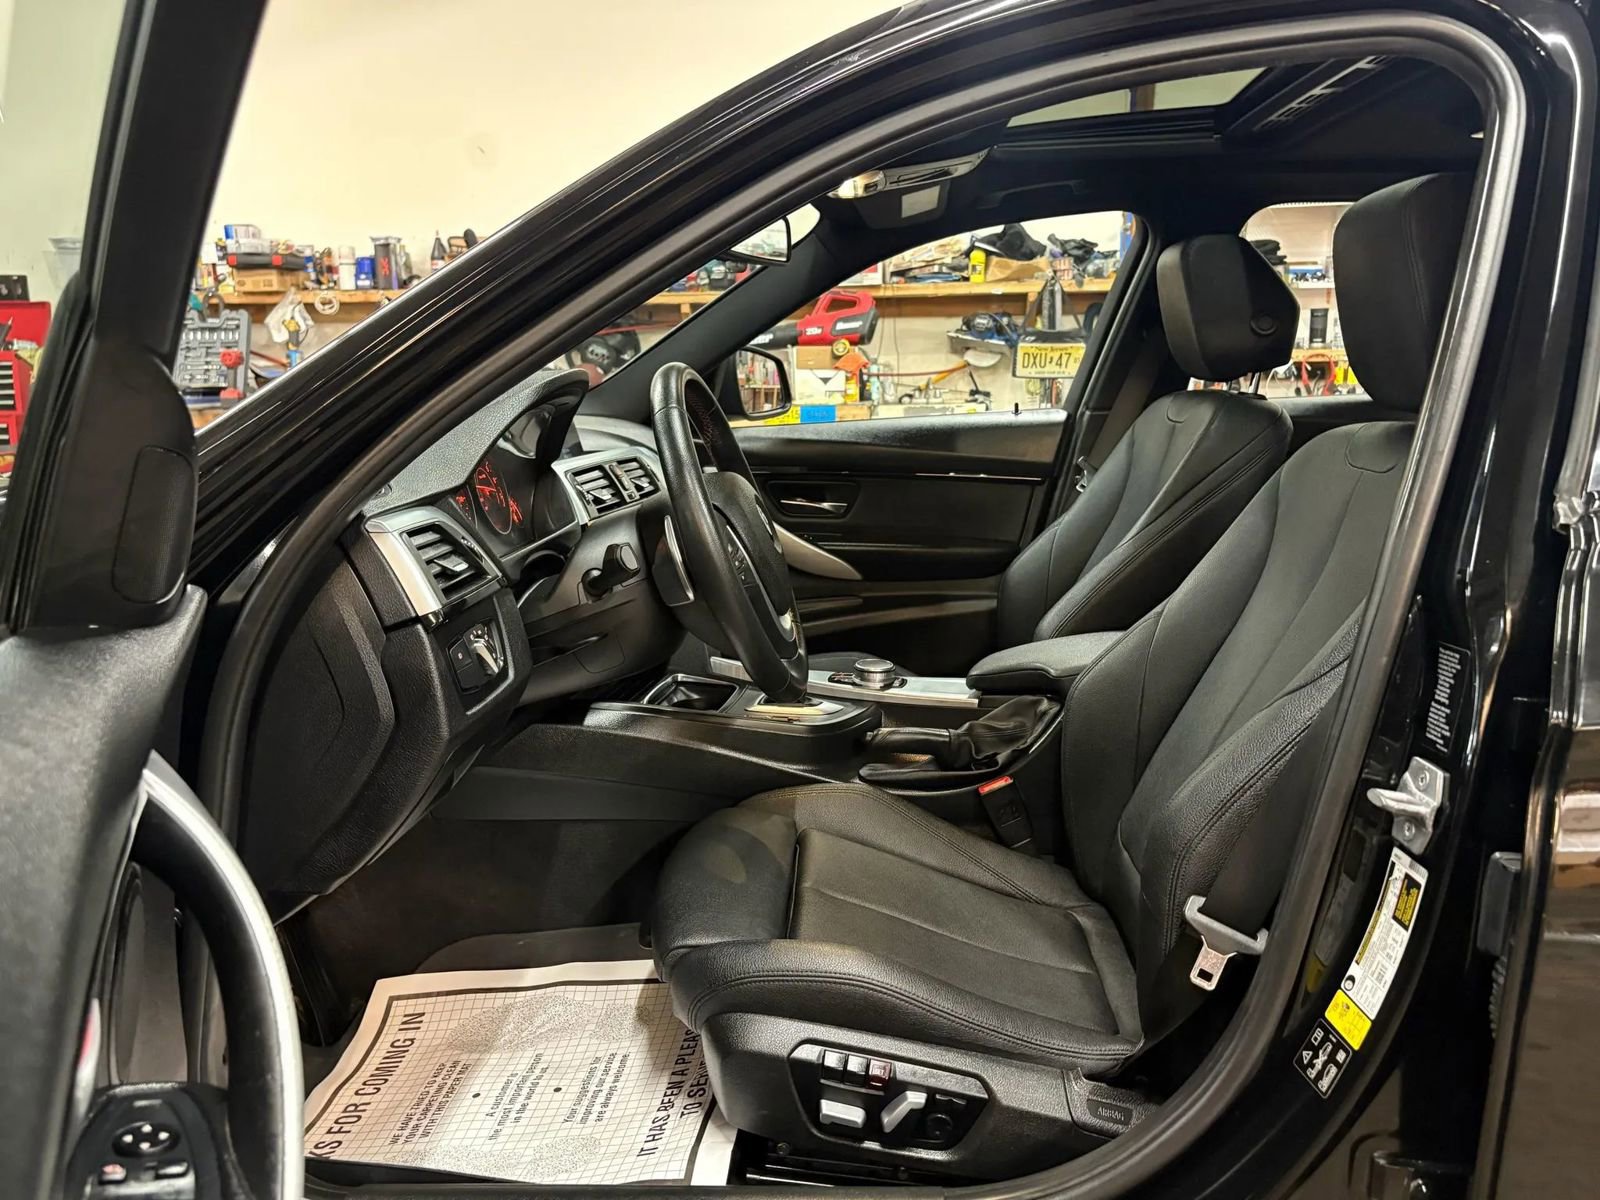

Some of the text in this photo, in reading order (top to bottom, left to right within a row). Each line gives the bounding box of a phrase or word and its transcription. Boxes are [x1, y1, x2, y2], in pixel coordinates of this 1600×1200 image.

[326, 1102, 371, 1134] FOR
[354, 1038, 416, 1096] COMING
[398, 1012, 425, 1031] IN
[388, 1063, 446, 1145] WE HAVE TRIED TO KEEP
[402, 1060, 461, 1144] YOUR CARPETING CLEAN
[419, 1063, 472, 1138] WITH THIS PAPER MAT
[488, 1053, 543, 1140] the most important person
[490, 1079, 514, 1110] customer
[515, 1103, 529, 1115] the
[523, 1082, 540, 1101] world
[562, 1056, 602, 1123] Your suggestions for
[576, 1052, 617, 1124] improving our service
[594, 1051, 631, 1122] are always welcome.
[657, 1080, 685, 1113] BEEN
[671, 1067, 690, 1076] A
[644, 1113, 671, 1143] HAS
[680, 1101, 703, 1118] TO
[637, 1146, 659, 1157] IT
